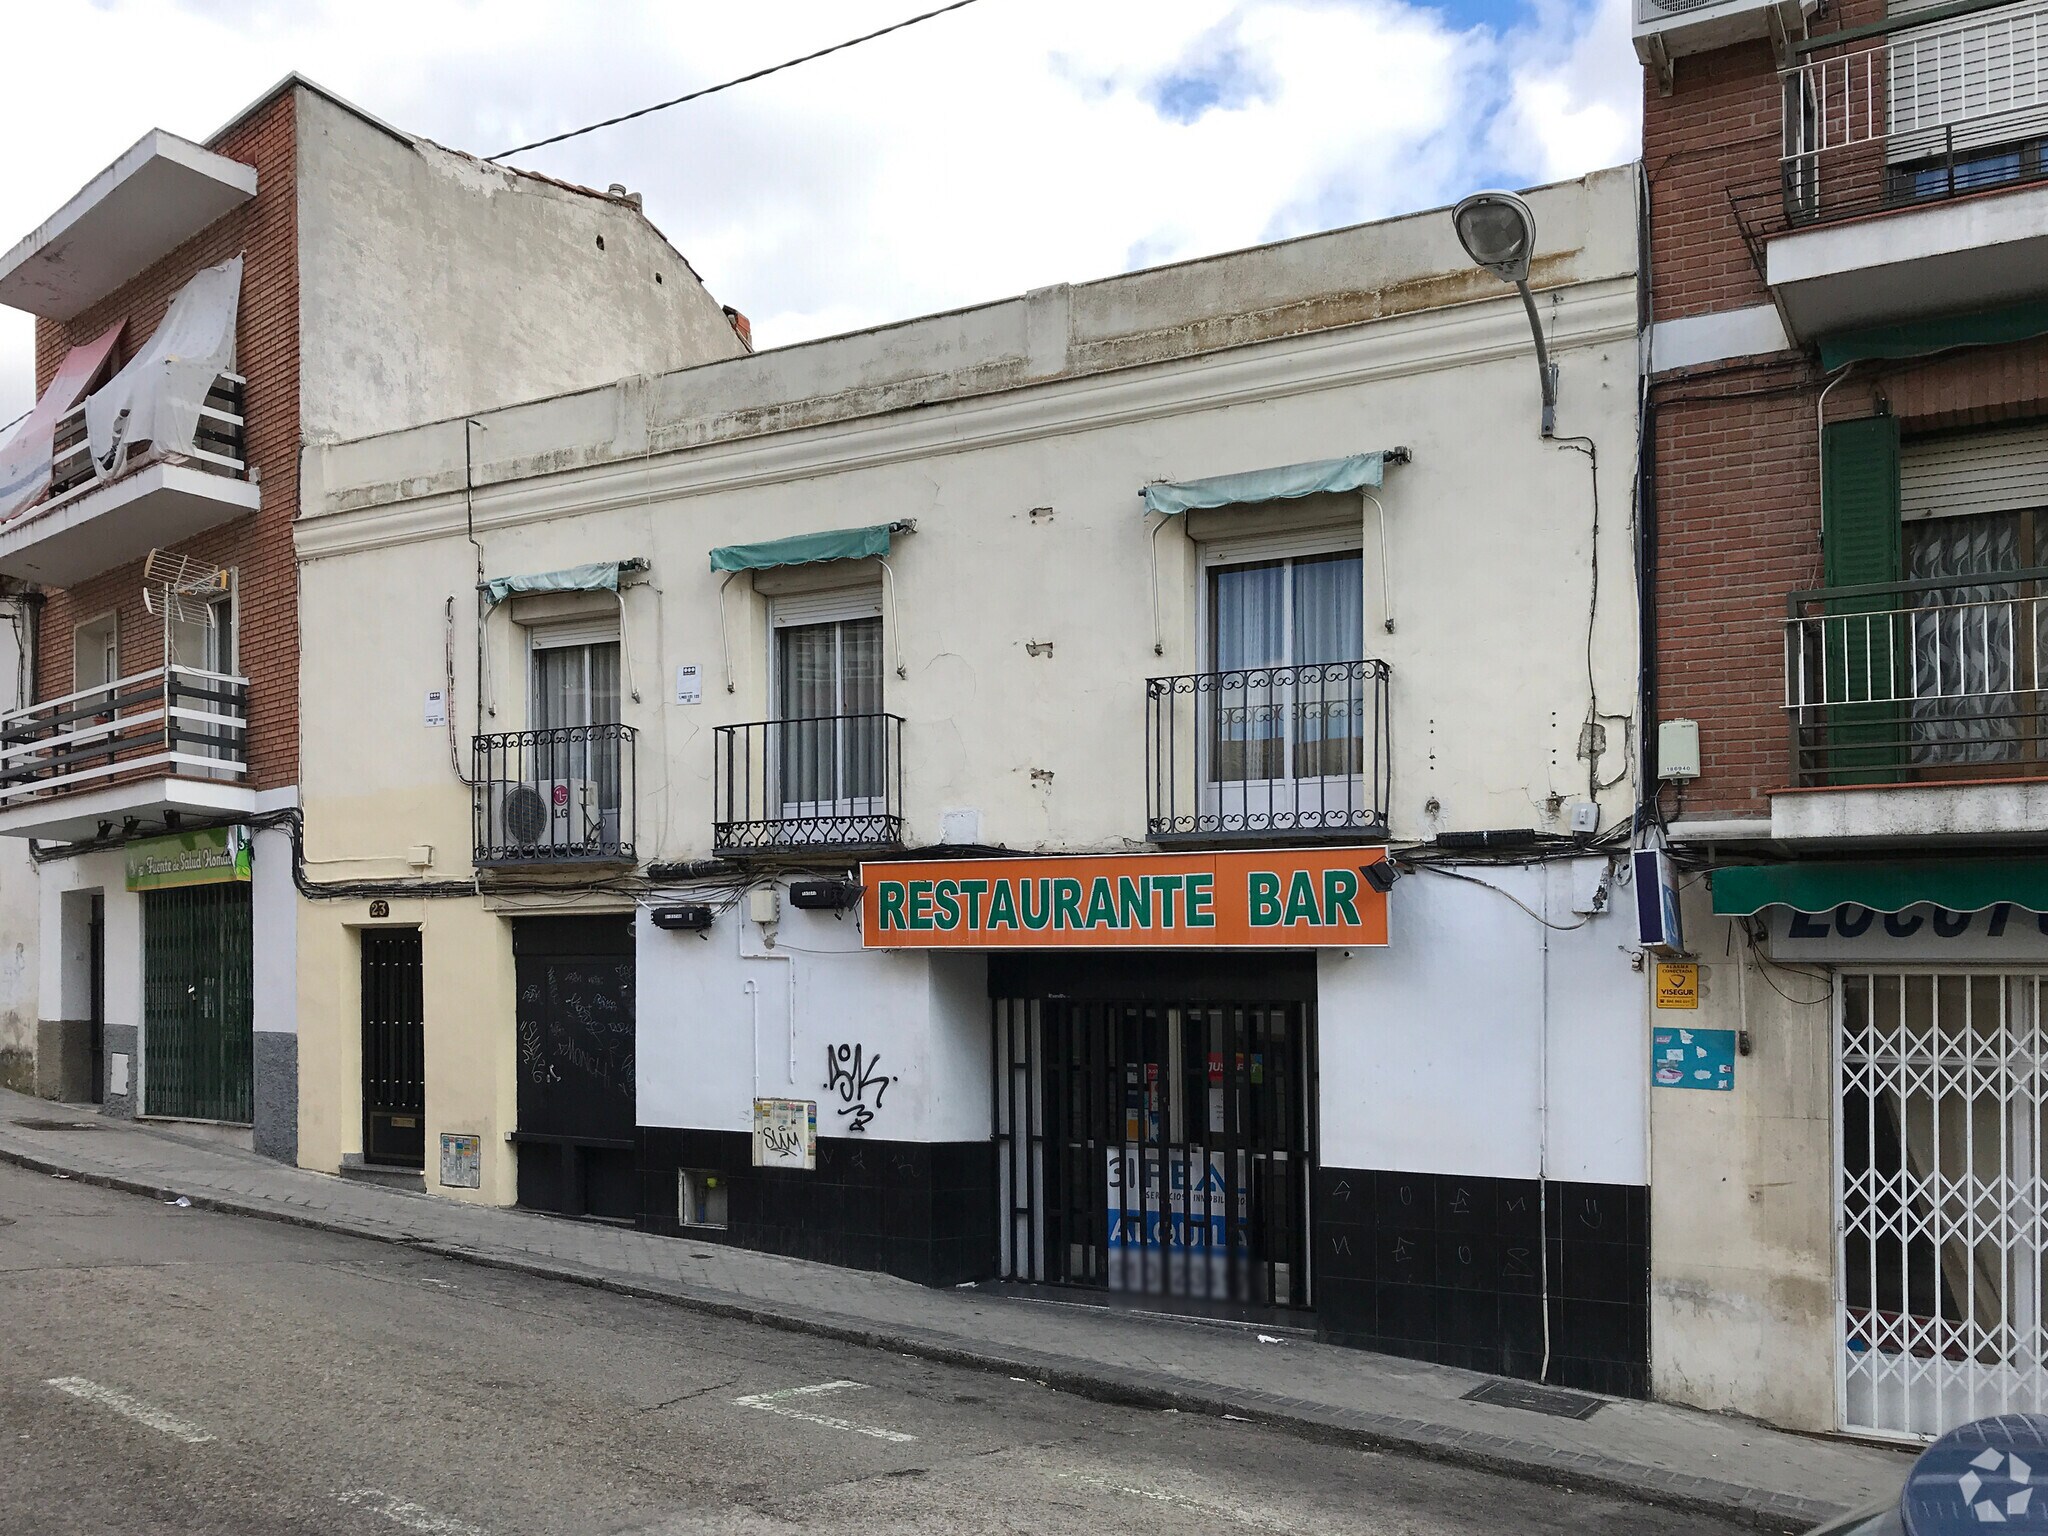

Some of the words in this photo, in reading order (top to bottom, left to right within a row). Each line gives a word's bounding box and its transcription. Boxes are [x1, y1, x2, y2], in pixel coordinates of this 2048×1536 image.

[554, 808, 569, 819] LG
[146, 856, 172, 875] Fuente
[172, 862, 180, 871] de
[180, 849, 202, 871] Salud
[371, 902, 386, 916] 23
[878, 873, 1216, 931] RESTAURANTE
[1248, 869, 1362, 928] BAR
